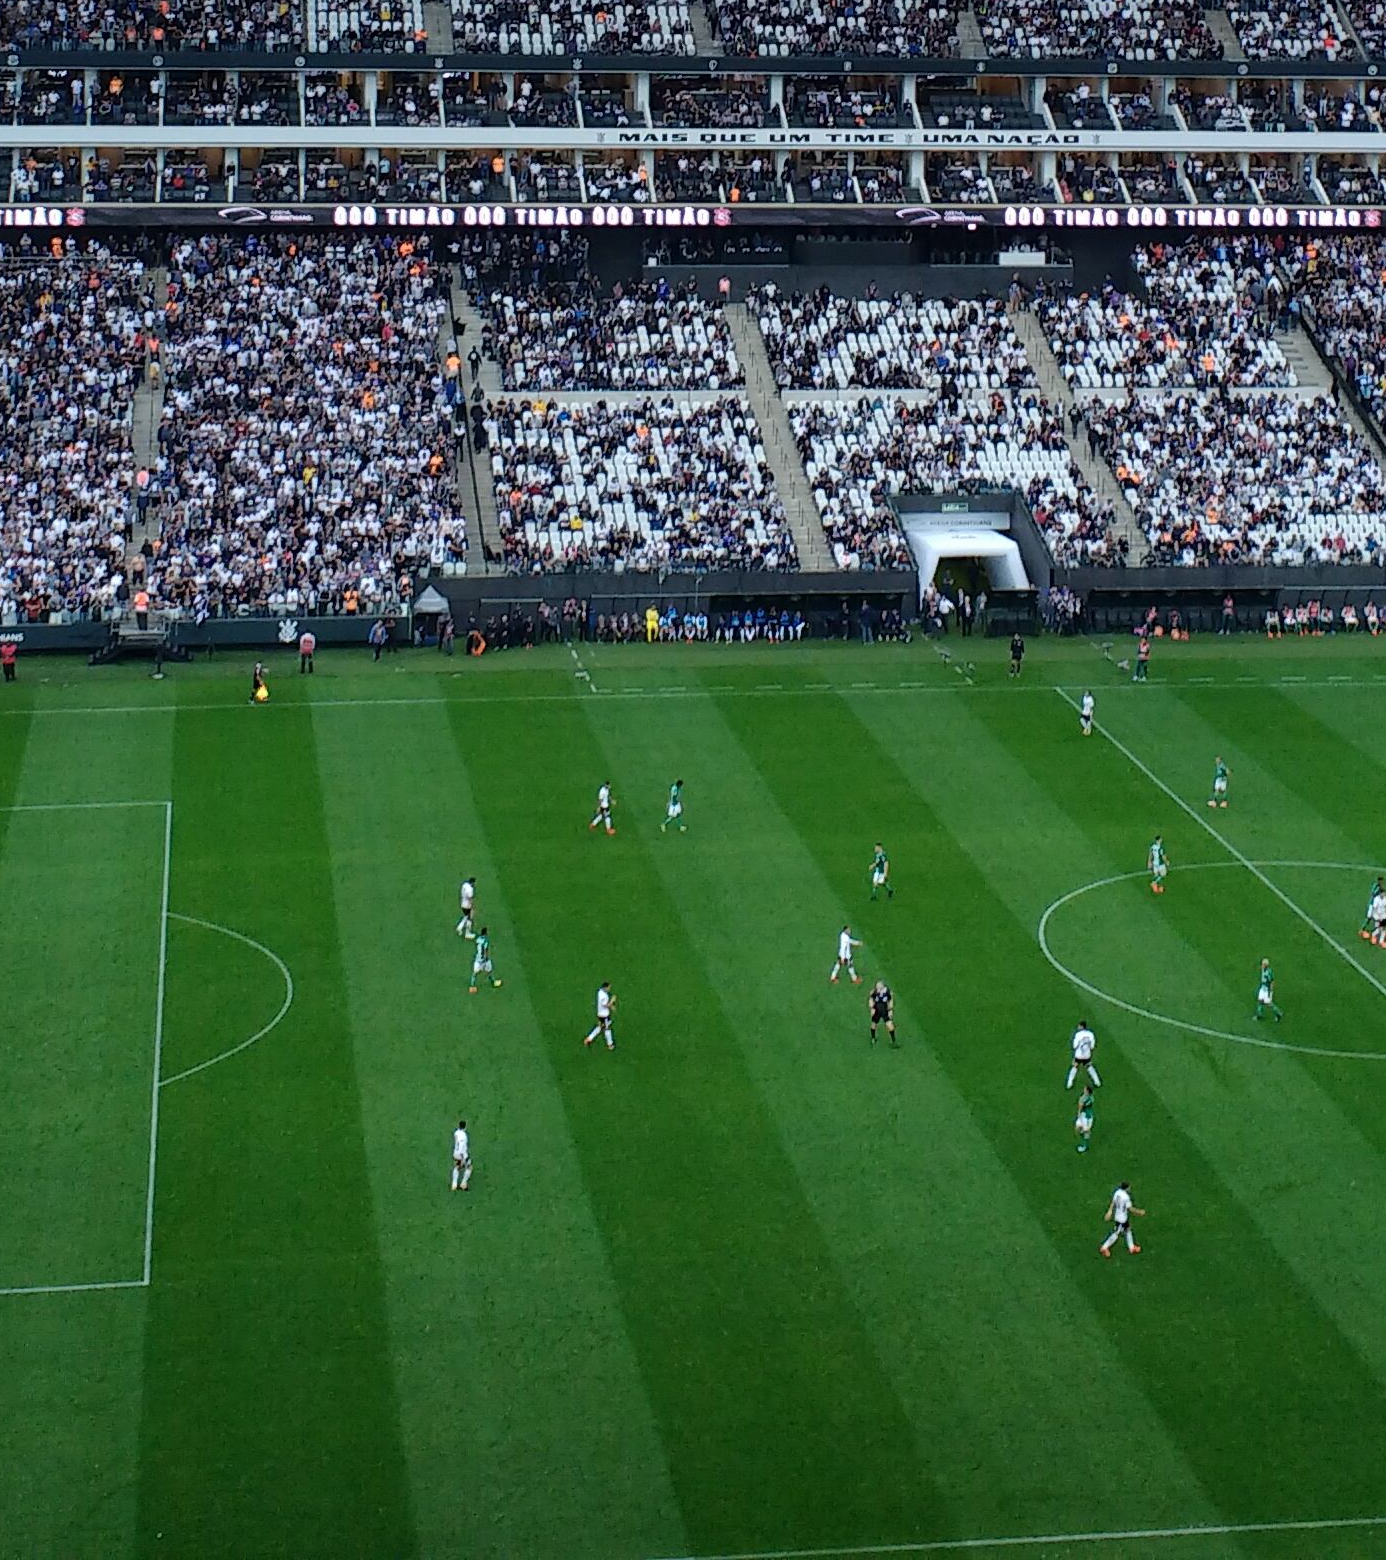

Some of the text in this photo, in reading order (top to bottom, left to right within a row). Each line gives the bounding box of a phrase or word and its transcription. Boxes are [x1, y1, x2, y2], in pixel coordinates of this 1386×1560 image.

[618, 132, 1081, 146] MAIS QUE UM TIME UMA NAÇÃO
[386, 206, 455, 225] TIMÃO
[515, 206, 583, 225] TIMÃO
[643, 206, 710, 225] TIMÃO
[1054, 207, 1119, 226] TIMÃO
[1175, 207, 1240, 226] TIMÃO
[1296, 208, 1361, 226] TIMÃO
